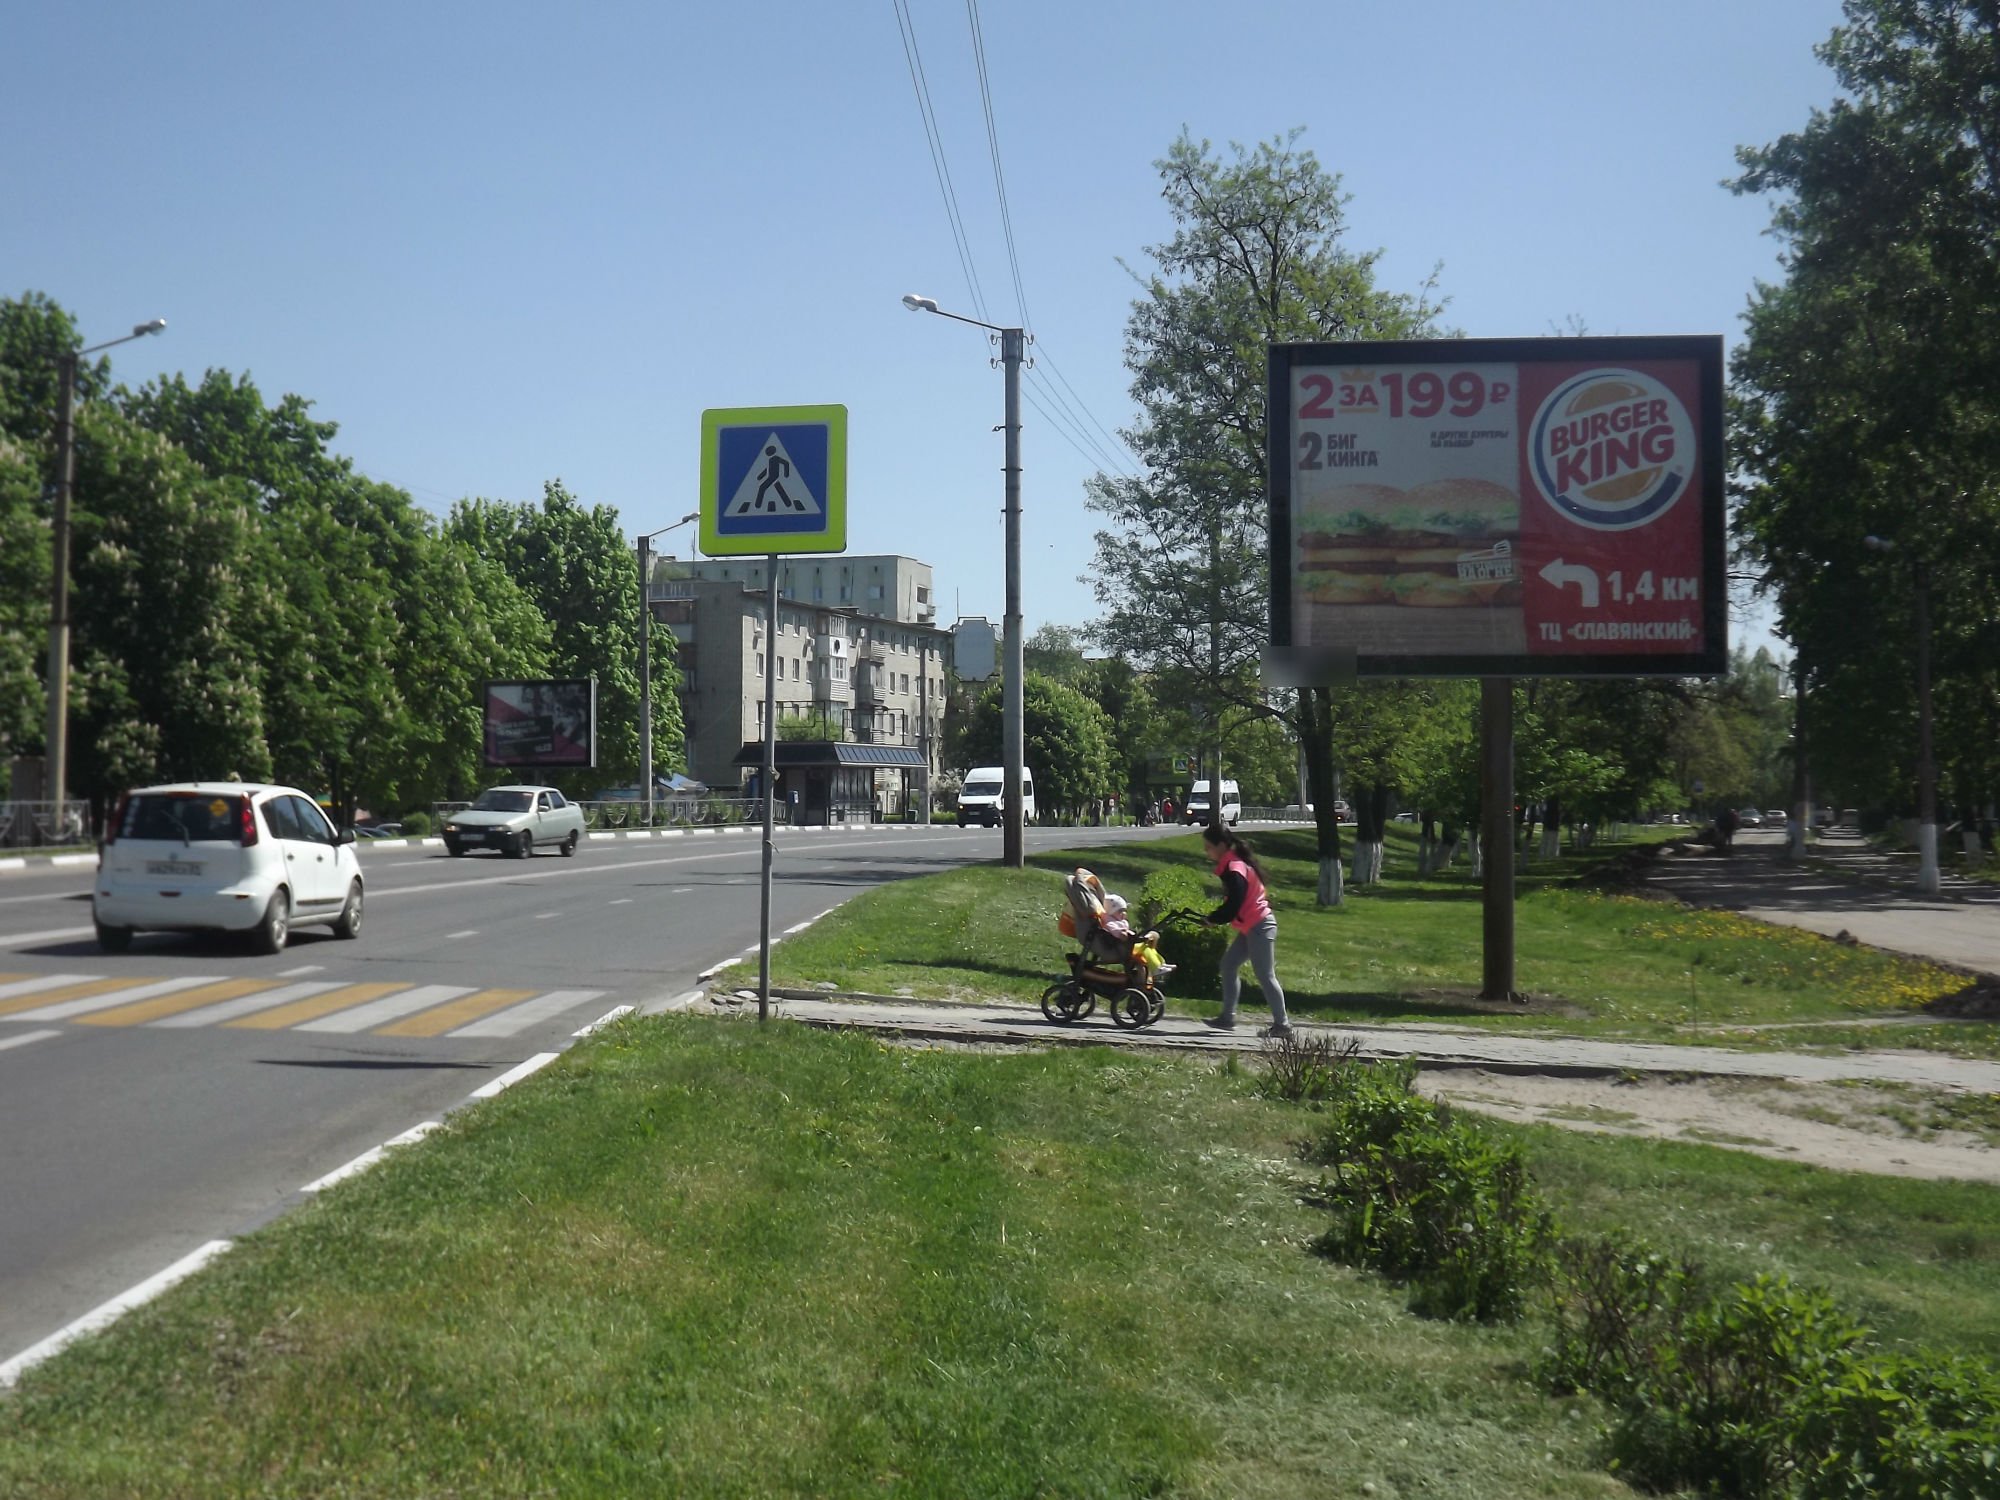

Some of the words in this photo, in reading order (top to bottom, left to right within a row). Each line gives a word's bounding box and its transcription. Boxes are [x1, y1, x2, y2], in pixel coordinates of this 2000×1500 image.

[1298, 373, 1335, 419] 2
[1338, 384, 1379, 407] ЗА
[1551, 398, 1669, 456] BURGER
[1298, 431, 1323, 471] 2
[1326, 433, 1358, 450] БИГ
[1326, 450, 1379, 467] КИНГА
[1556, 424, 1675, 495] KING
[1606, 570, 1655, 605] 1,4
[1538, 622, 1563, 642] ТЦ
